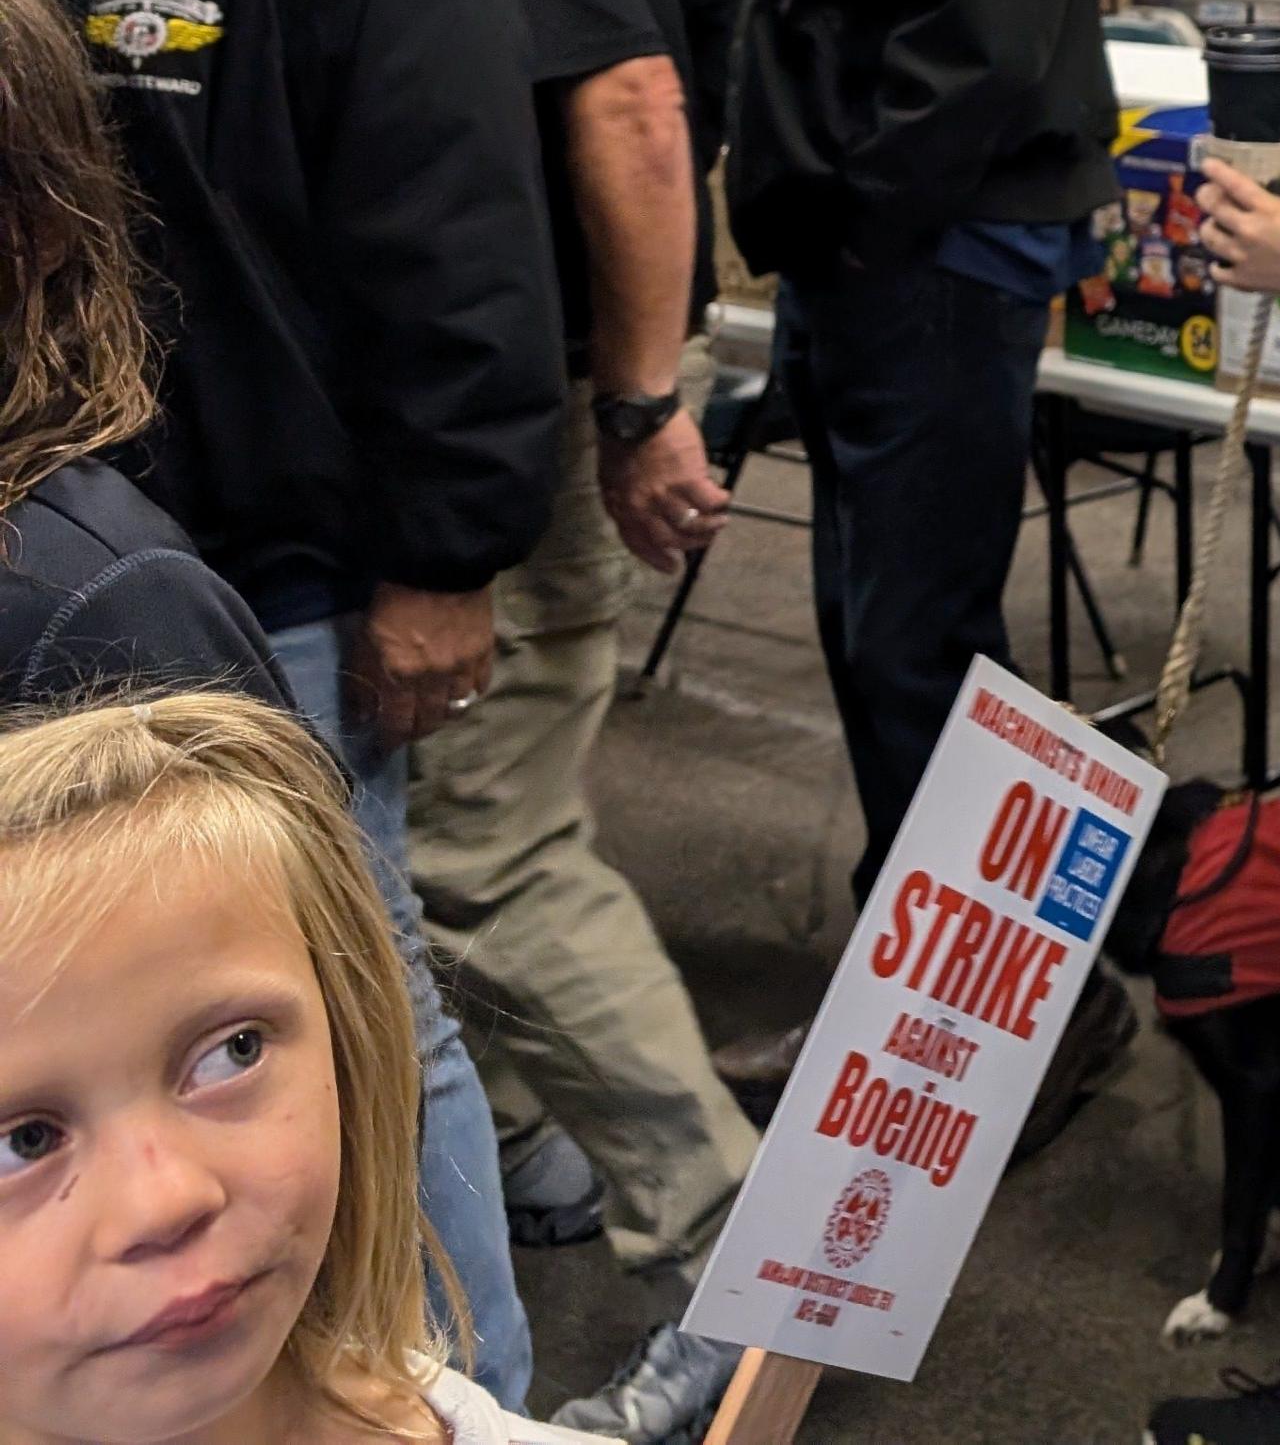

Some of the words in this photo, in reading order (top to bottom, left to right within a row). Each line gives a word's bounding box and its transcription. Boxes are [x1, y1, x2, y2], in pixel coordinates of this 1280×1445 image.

[978, 780, 1069, 902] ON
[870, 869, 1069, 1042] STRIKE
[815, 1050, 980, 1188] Boeing
